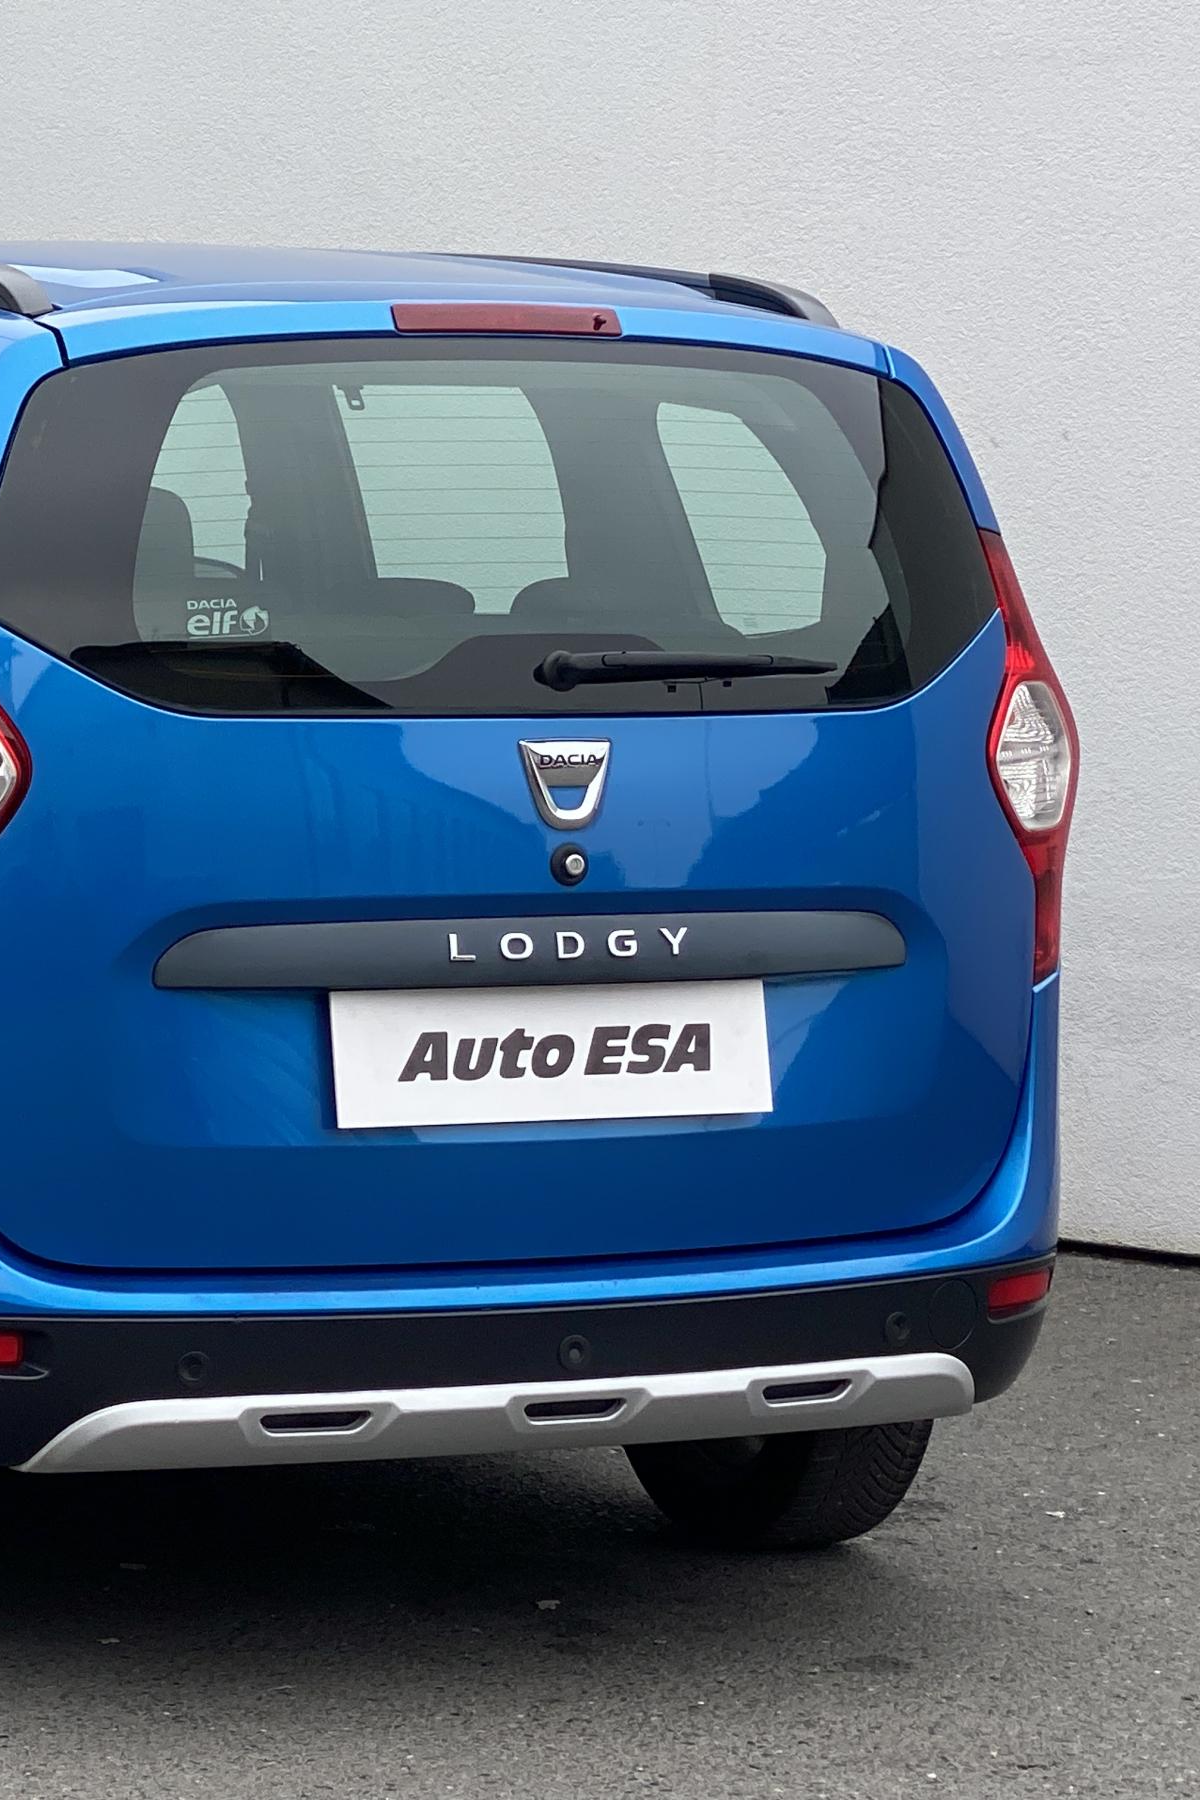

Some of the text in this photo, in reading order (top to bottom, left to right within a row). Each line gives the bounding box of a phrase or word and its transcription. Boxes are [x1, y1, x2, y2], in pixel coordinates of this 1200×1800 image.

[186, 598, 238, 610] DACIA
[186, 610, 239, 635] elf
[539, 754, 600, 767] DACIA
[447, 926, 689, 962] LODGY
[397, 1022, 712, 1083] Auto ESA
